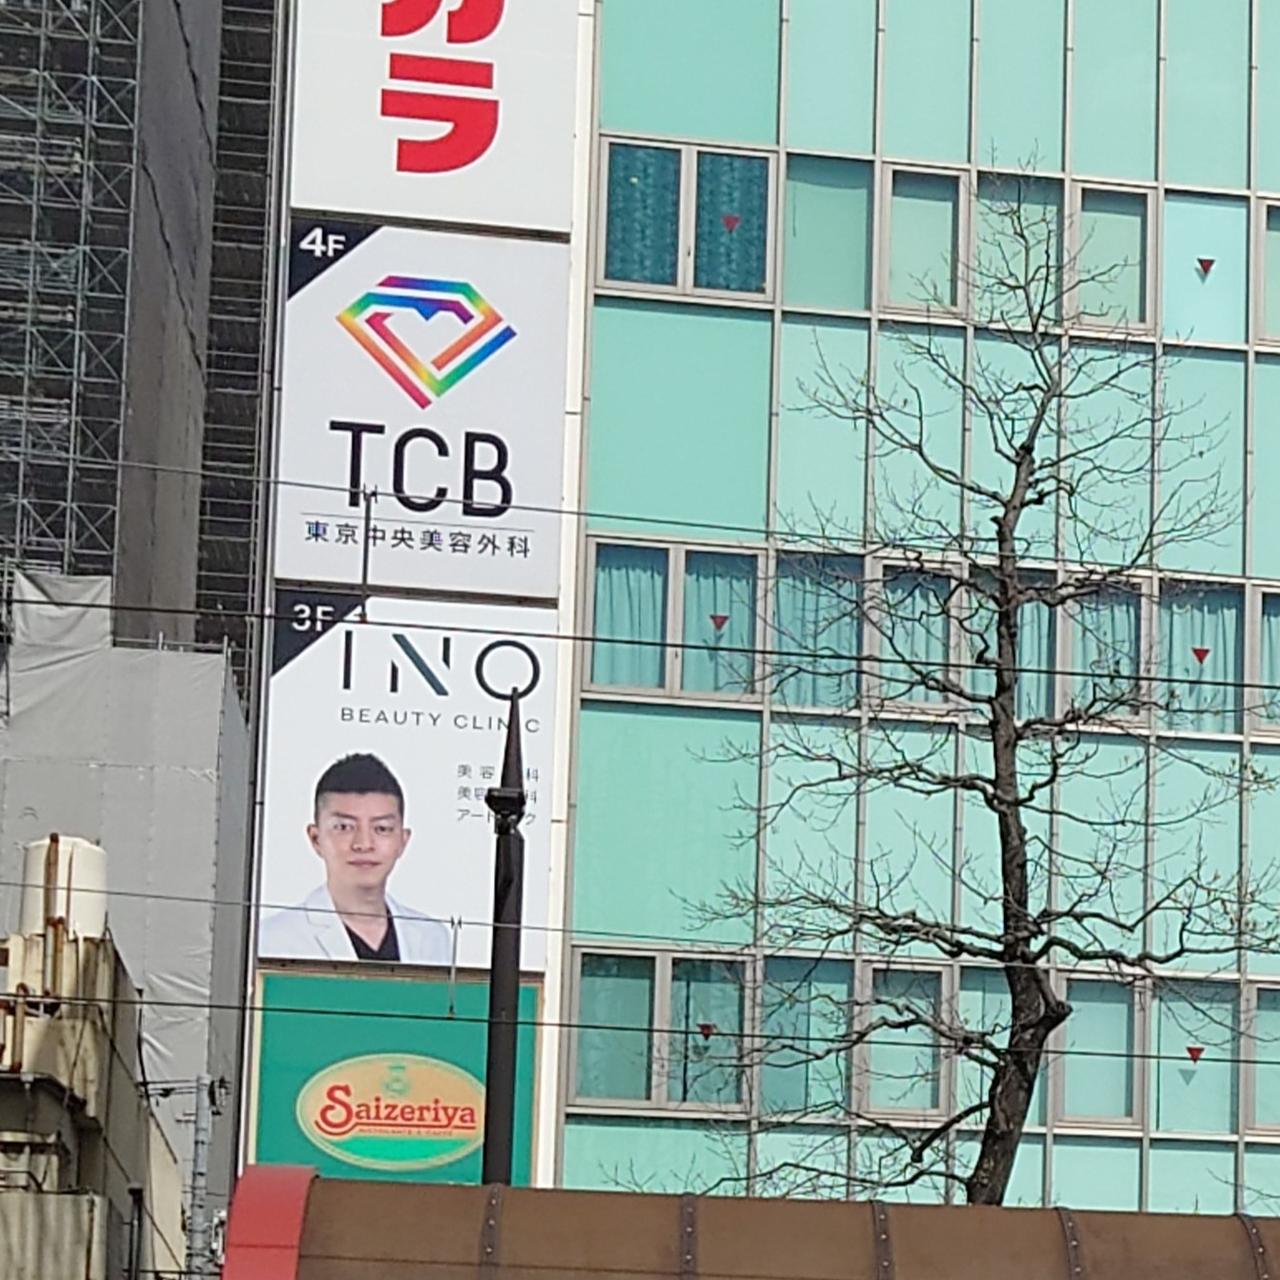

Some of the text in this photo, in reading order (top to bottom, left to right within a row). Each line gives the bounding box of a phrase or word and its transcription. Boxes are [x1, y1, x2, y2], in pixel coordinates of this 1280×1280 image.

[299, 227, 346, 257] 4F
[329, 420, 513, 518] TCB
[305, 519, 530, 559] 東京中央美容外科
[291, 604, 335, 632] 3F
[343, 630, 541, 702] INO
[341, 707, 541, 734] BEAUTY CLINC
[320, 1084, 476, 1129] Saizeriya
